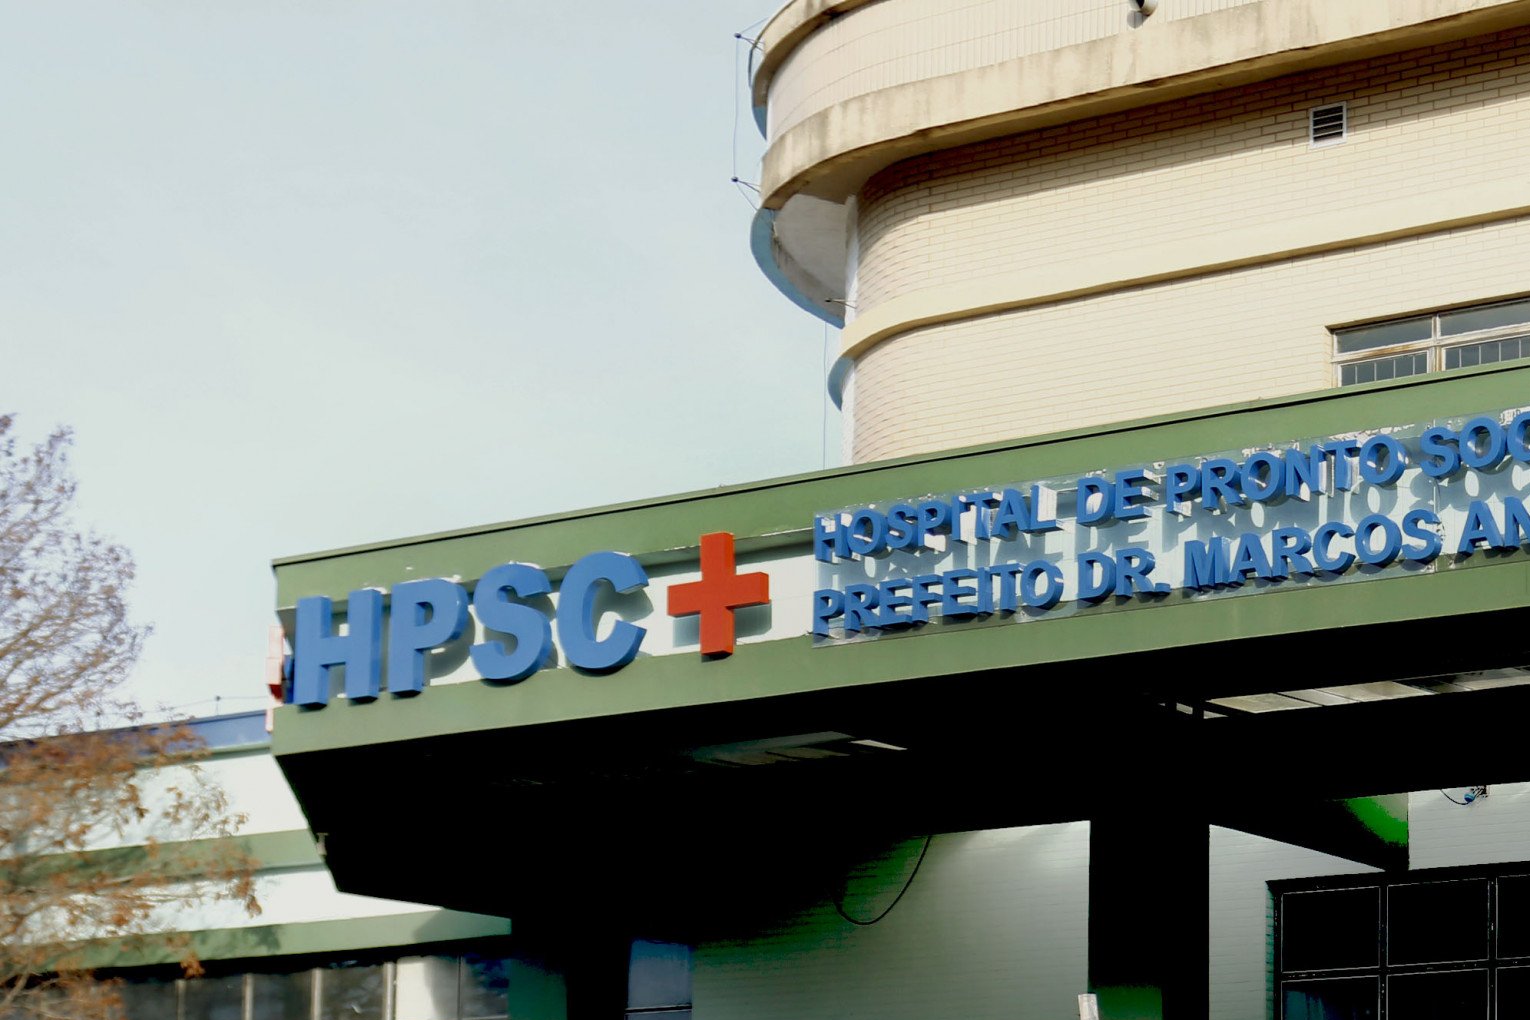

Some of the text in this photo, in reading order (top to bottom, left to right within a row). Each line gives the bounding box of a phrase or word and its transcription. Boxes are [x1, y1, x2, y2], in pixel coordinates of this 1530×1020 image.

[814, 484, 1062, 563] HOSPITAL
[1077, 468, 1158, 527] DE
[1165, 433, 1407, 516] PRONTO
[295, 551, 649, 707] HPSC
[812, 559, 1064, 637] PREFEITO
[1077, 547, 1171, 602] DR.
[1184, 509, 1443, 592] MARCOS
